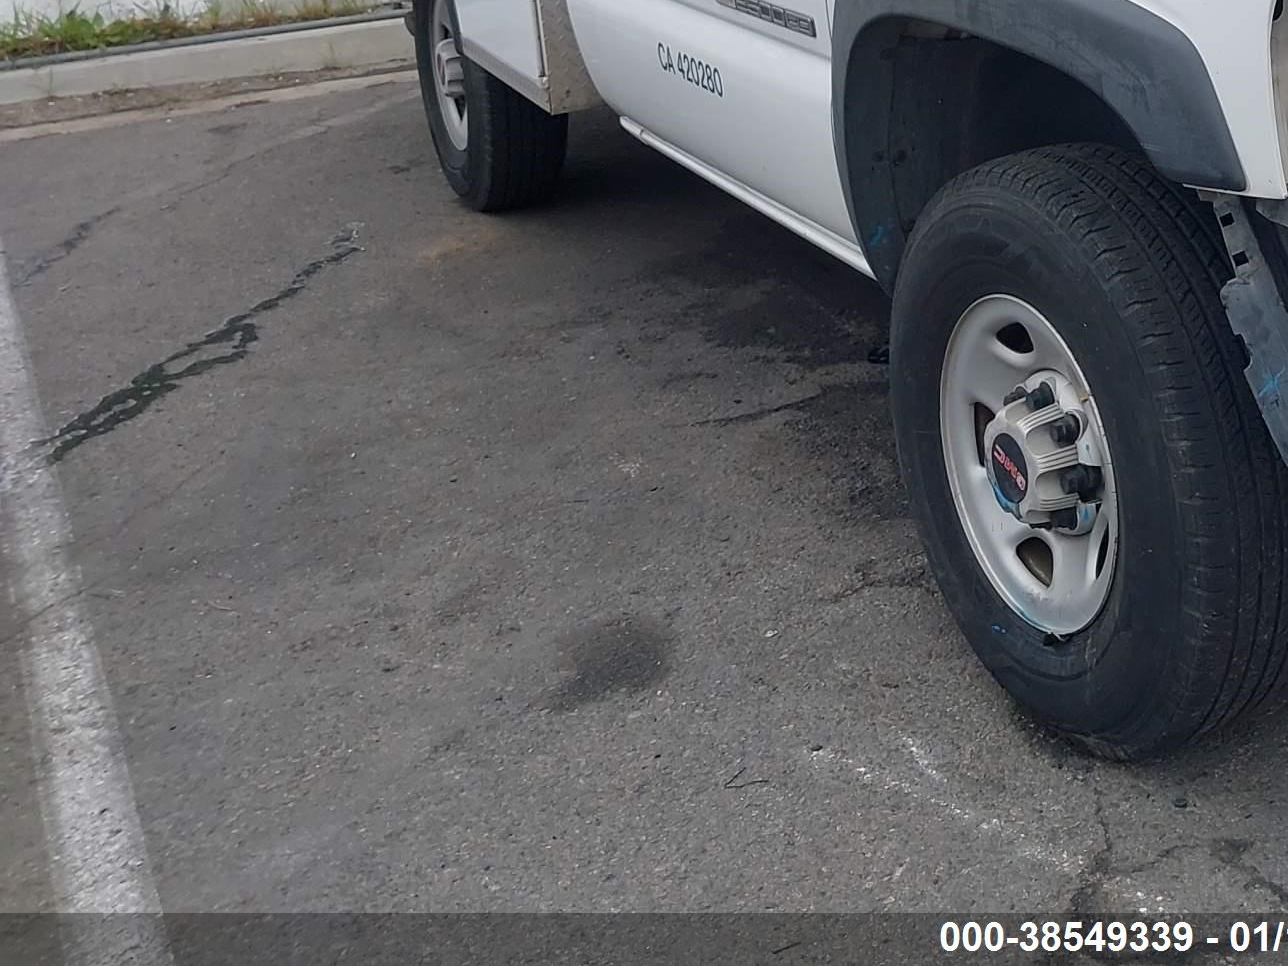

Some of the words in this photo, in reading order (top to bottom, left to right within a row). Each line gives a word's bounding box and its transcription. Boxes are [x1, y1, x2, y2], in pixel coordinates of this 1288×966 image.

[657, 41, 677, 75] CA
[677, 51, 724, 98] 420280
[993, 443, 1026, 491] GMC
